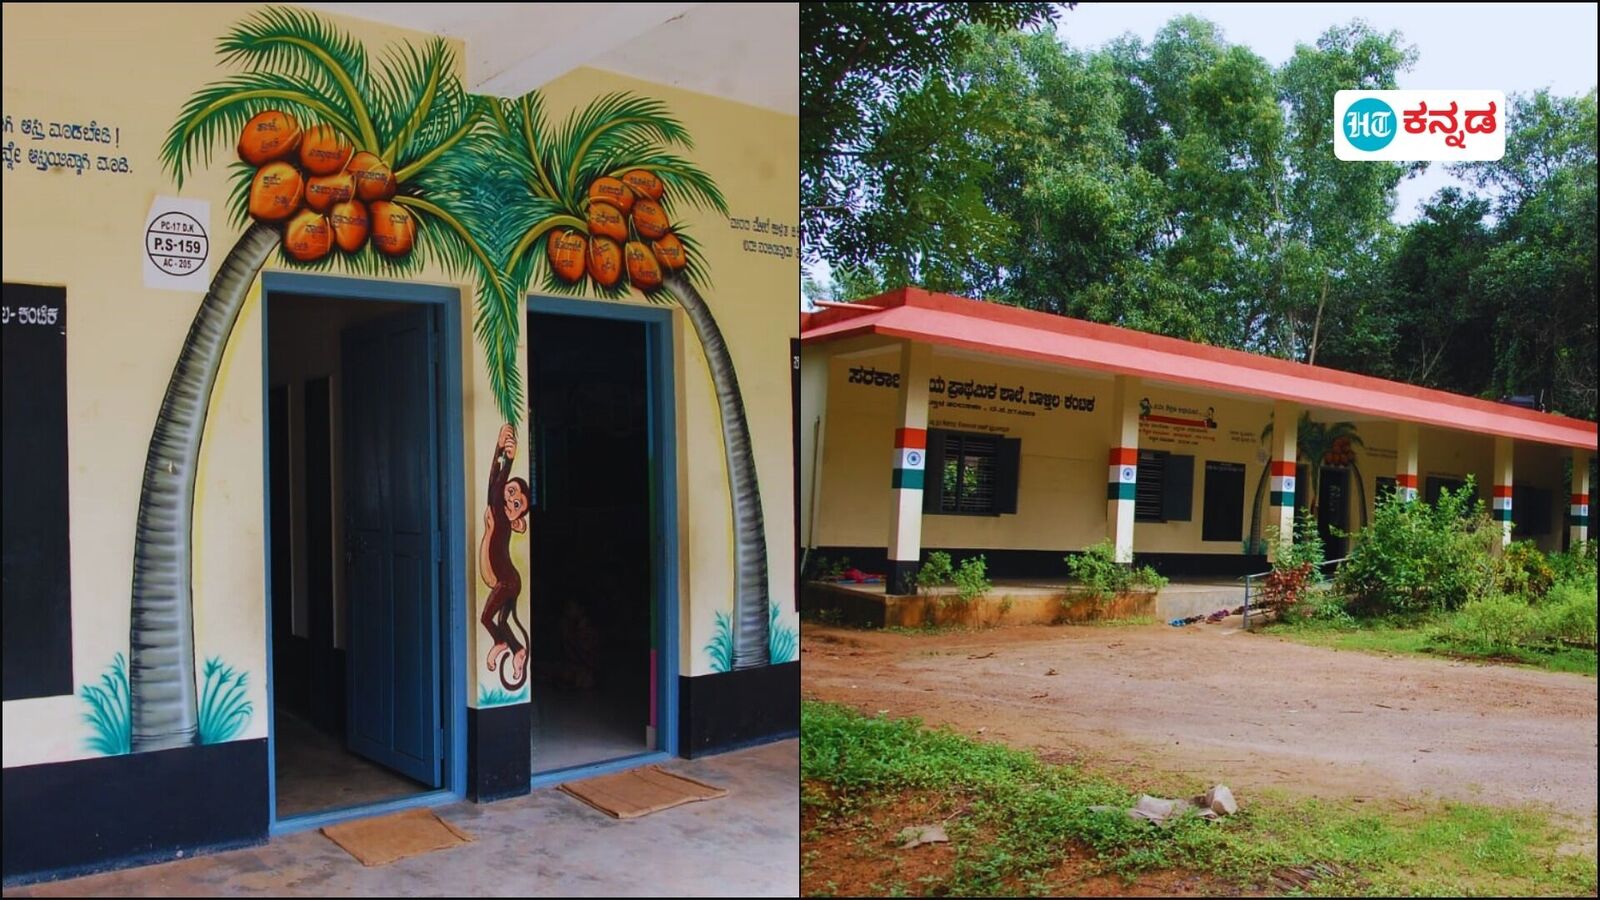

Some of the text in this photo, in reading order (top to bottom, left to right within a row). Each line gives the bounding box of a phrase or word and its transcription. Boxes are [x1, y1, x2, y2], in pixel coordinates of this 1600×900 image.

[160, 221, 181, 231] PC-17
[154, 237, 201, 254] P.S-159
[163, 258, 173, 267] AC
[178, 259, 192, 269] 205
[18, 304, 59, 325] ಕಂಟಿಕ
[948, 379, 997, 400] ಪ್ರಾಥಮಿಕ
